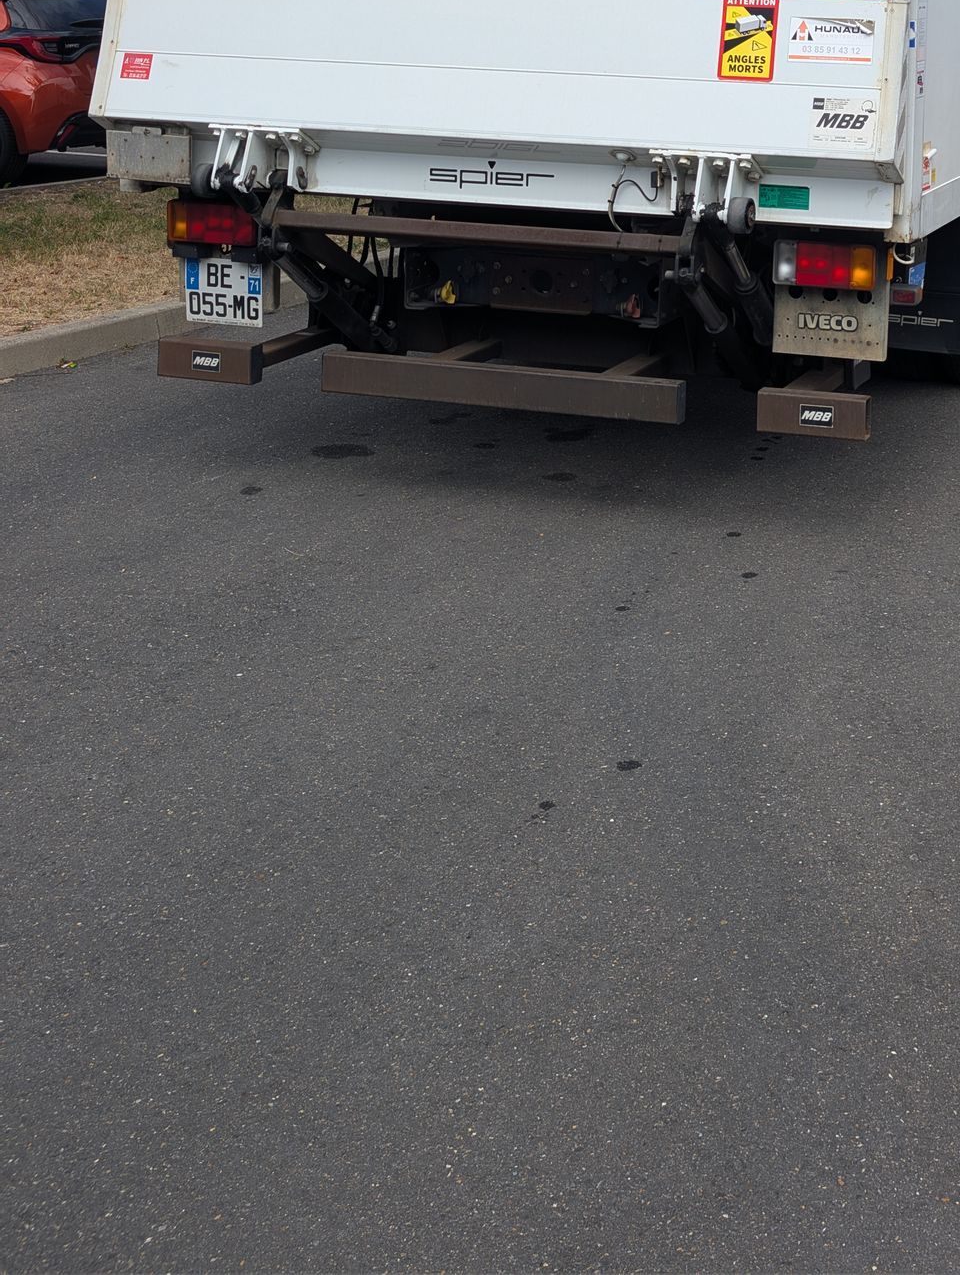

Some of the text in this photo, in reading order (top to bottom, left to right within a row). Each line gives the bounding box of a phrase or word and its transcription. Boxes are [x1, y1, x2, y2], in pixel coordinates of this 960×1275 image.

[802, 45, 811, 53] 03
[826, 46, 836, 54] 91
[839, 46, 848, 54] 43
[852, 47, 861, 55] 12
[727, 54, 766, 65] ANGLES
[728, 64, 764, 74] MORTS
[816, 112, 869, 130] MBB
[429, 161, 555, 189] spier
[190, 277, 195, 285] F
[249, 280, 259, 292] 71
[189, 291, 259, 321] 055-MG
[798, 313, 859, 332] IVECO
[193, 355, 219, 367] MBB
[801, 410, 832, 422] MBB
